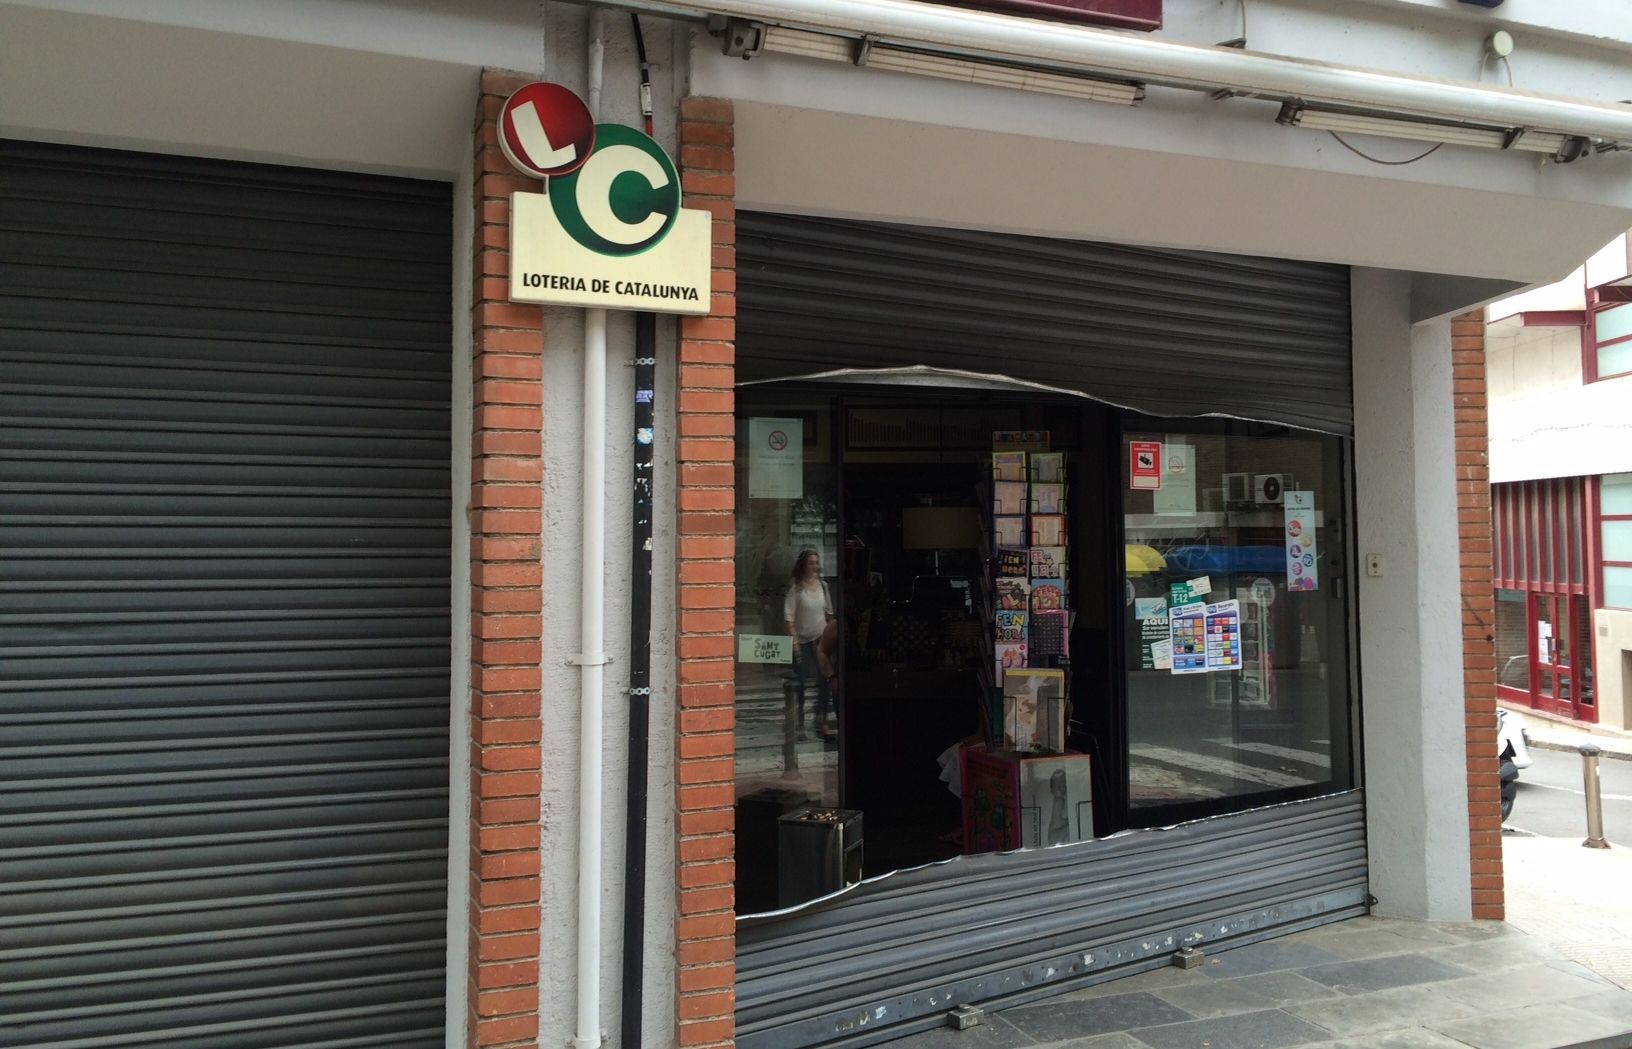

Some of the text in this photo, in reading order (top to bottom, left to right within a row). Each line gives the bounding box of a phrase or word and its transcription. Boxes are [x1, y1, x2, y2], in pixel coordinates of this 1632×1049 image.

[523, 273, 699, 301] LOTERIA DE CATALUNYA
